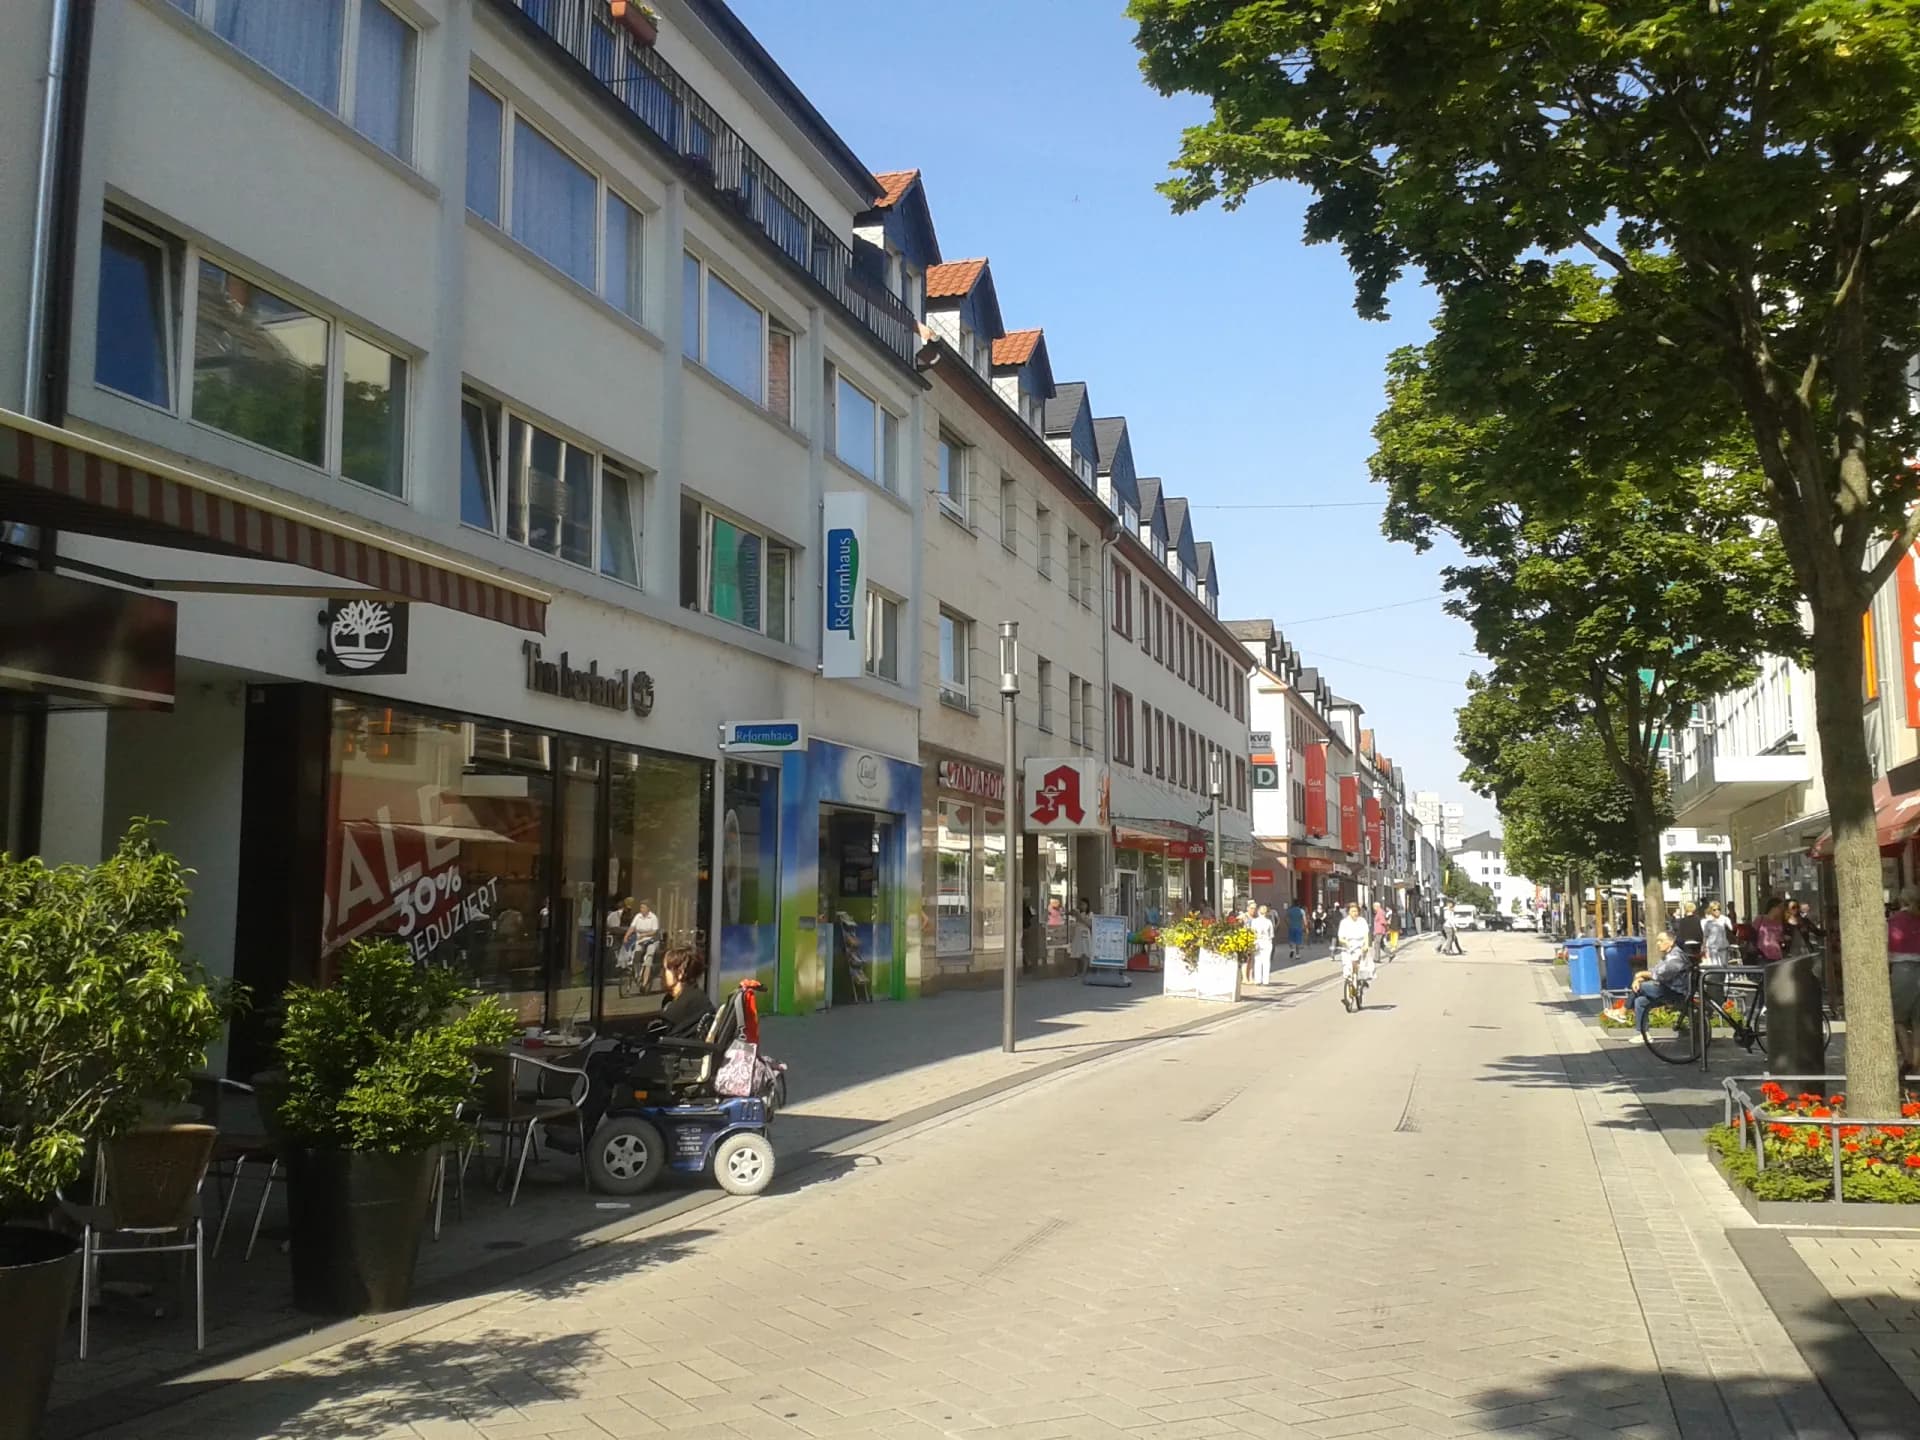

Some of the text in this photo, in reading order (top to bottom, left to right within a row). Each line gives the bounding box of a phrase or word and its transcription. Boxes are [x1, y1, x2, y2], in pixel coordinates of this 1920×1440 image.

[834, 537, 853, 628] Reformhaus
[522, 639, 629, 712] Timberland
[736, 728, 794, 742] Reformhaus
[1257, 768, 1275, 786] D
[393, 865, 462, 937] 30%
